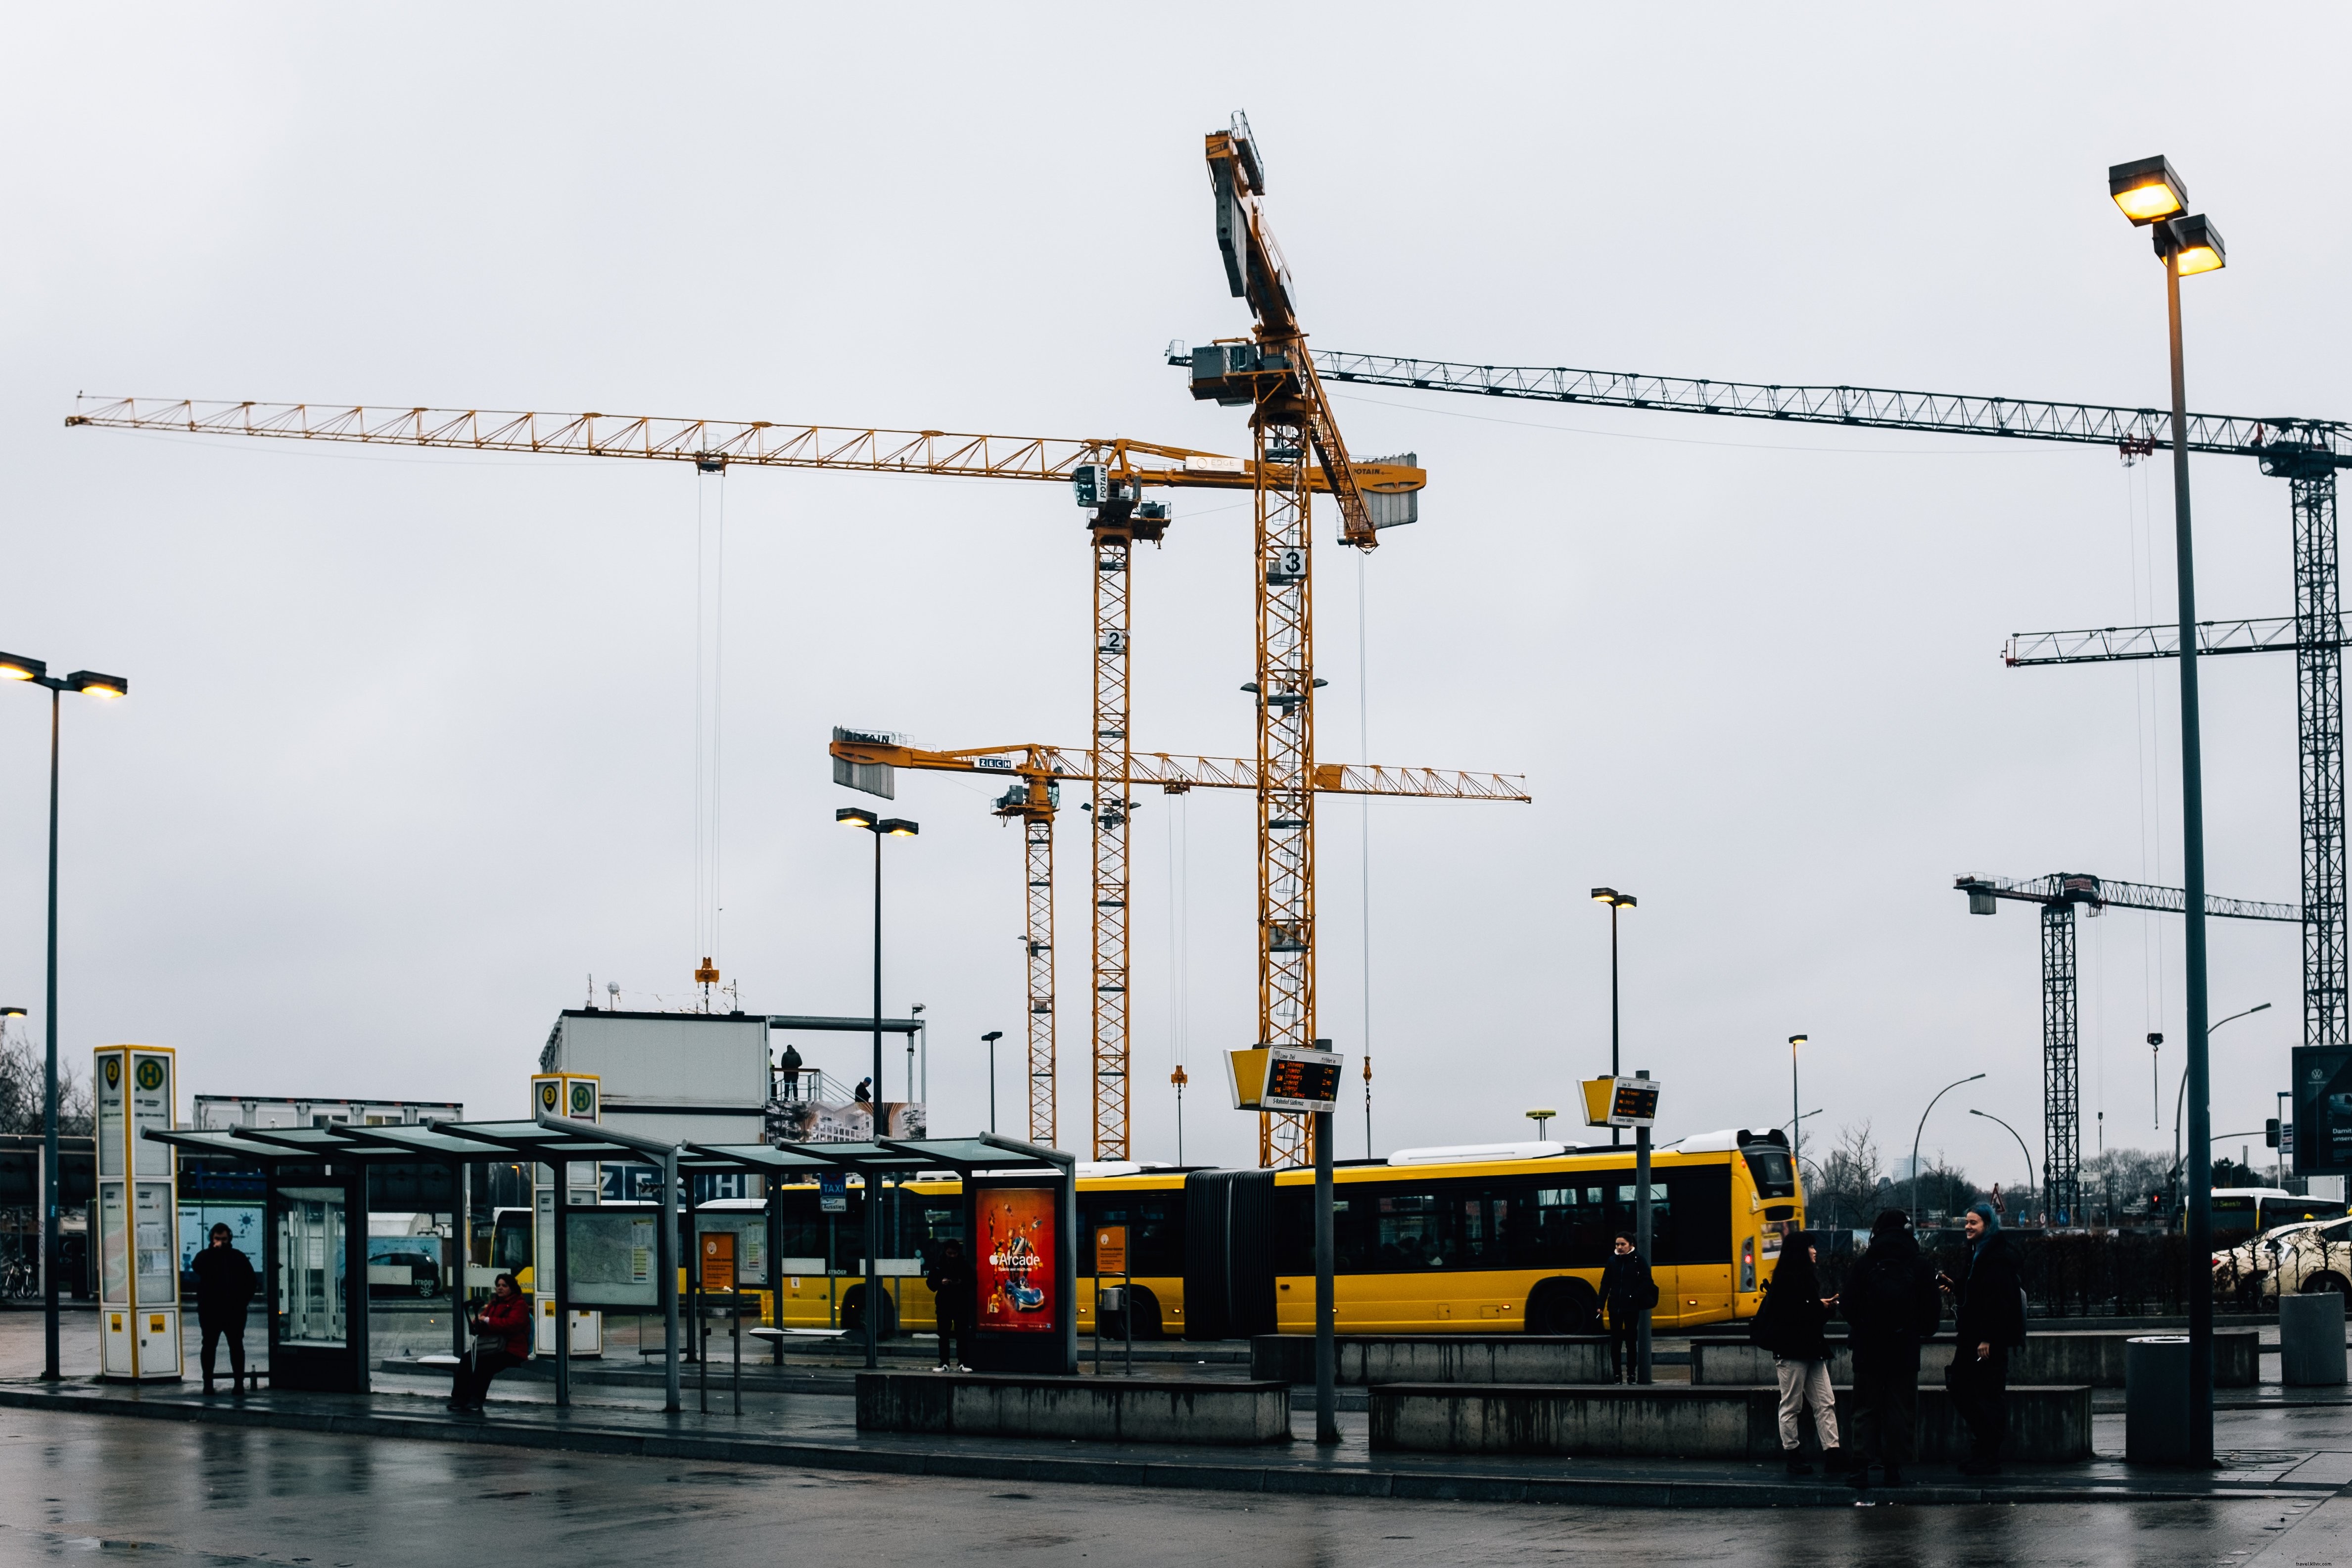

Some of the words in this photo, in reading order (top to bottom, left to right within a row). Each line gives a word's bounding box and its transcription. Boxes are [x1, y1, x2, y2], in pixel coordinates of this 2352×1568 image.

[1285, 552, 1301, 572] 3
[1109, 632, 1120, 647] 2
[110, 1065, 115, 1077] 2
[143, 1066, 156, 1083] H
[547, 1090, 552, 1101] 3
[576, 1091, 586, 1106] H
[823, 1184, 843, 1193] TAXI
[999, 1253, 1040, 1266] Arcade
[151, 1323, 164, 1331] BVG
